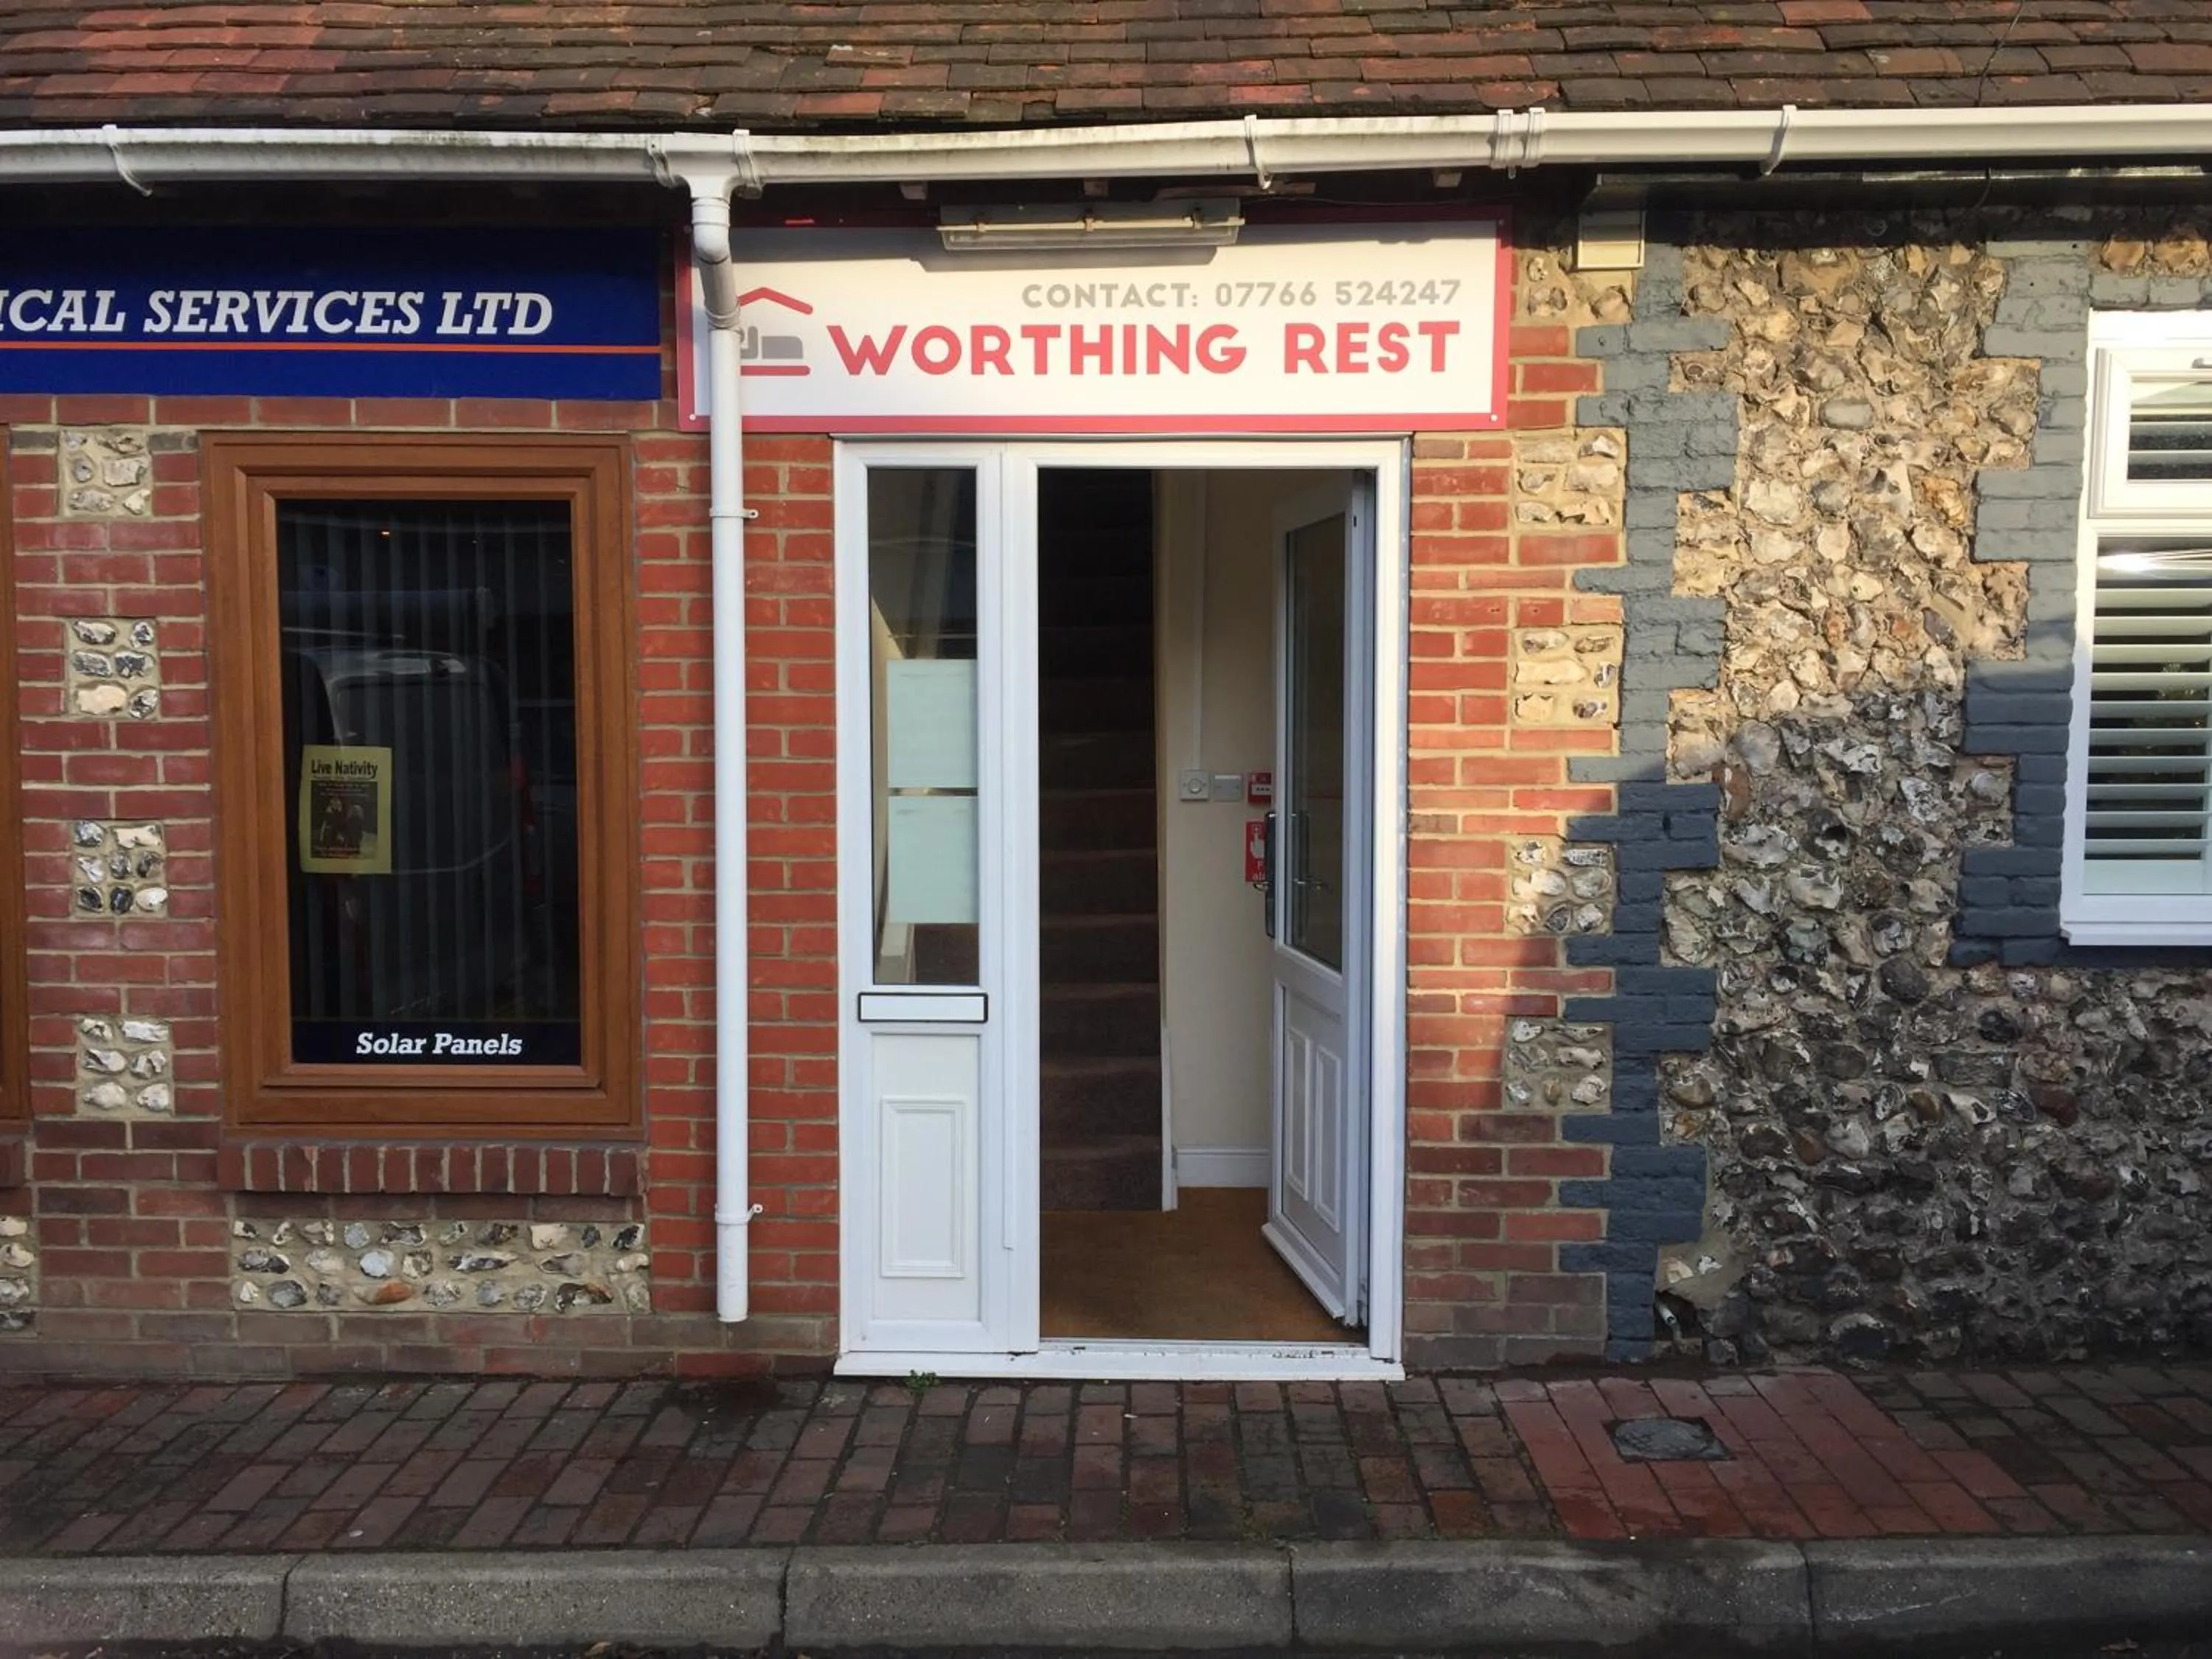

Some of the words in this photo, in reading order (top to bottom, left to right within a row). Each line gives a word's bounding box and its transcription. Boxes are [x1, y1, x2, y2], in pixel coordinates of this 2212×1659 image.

[1022, 282, 1199, 308] CONTACT:
[1216, 282, 1317, 307] 07766
[1335, 280, 1461, 305] 524247
[143, 291, 424, 334] SERVICES
[436, 292, 552, 335] LTD
[827, 324, 1247, 375] WORTHING
[1284, 320, 1461, 374] REST
[311, 759, 332, 774] Live
[335, 759, 378, 779] Nativity
[355, 1032, 427, 1054] Solar
[431, 1032, 523, 1055] Panels
